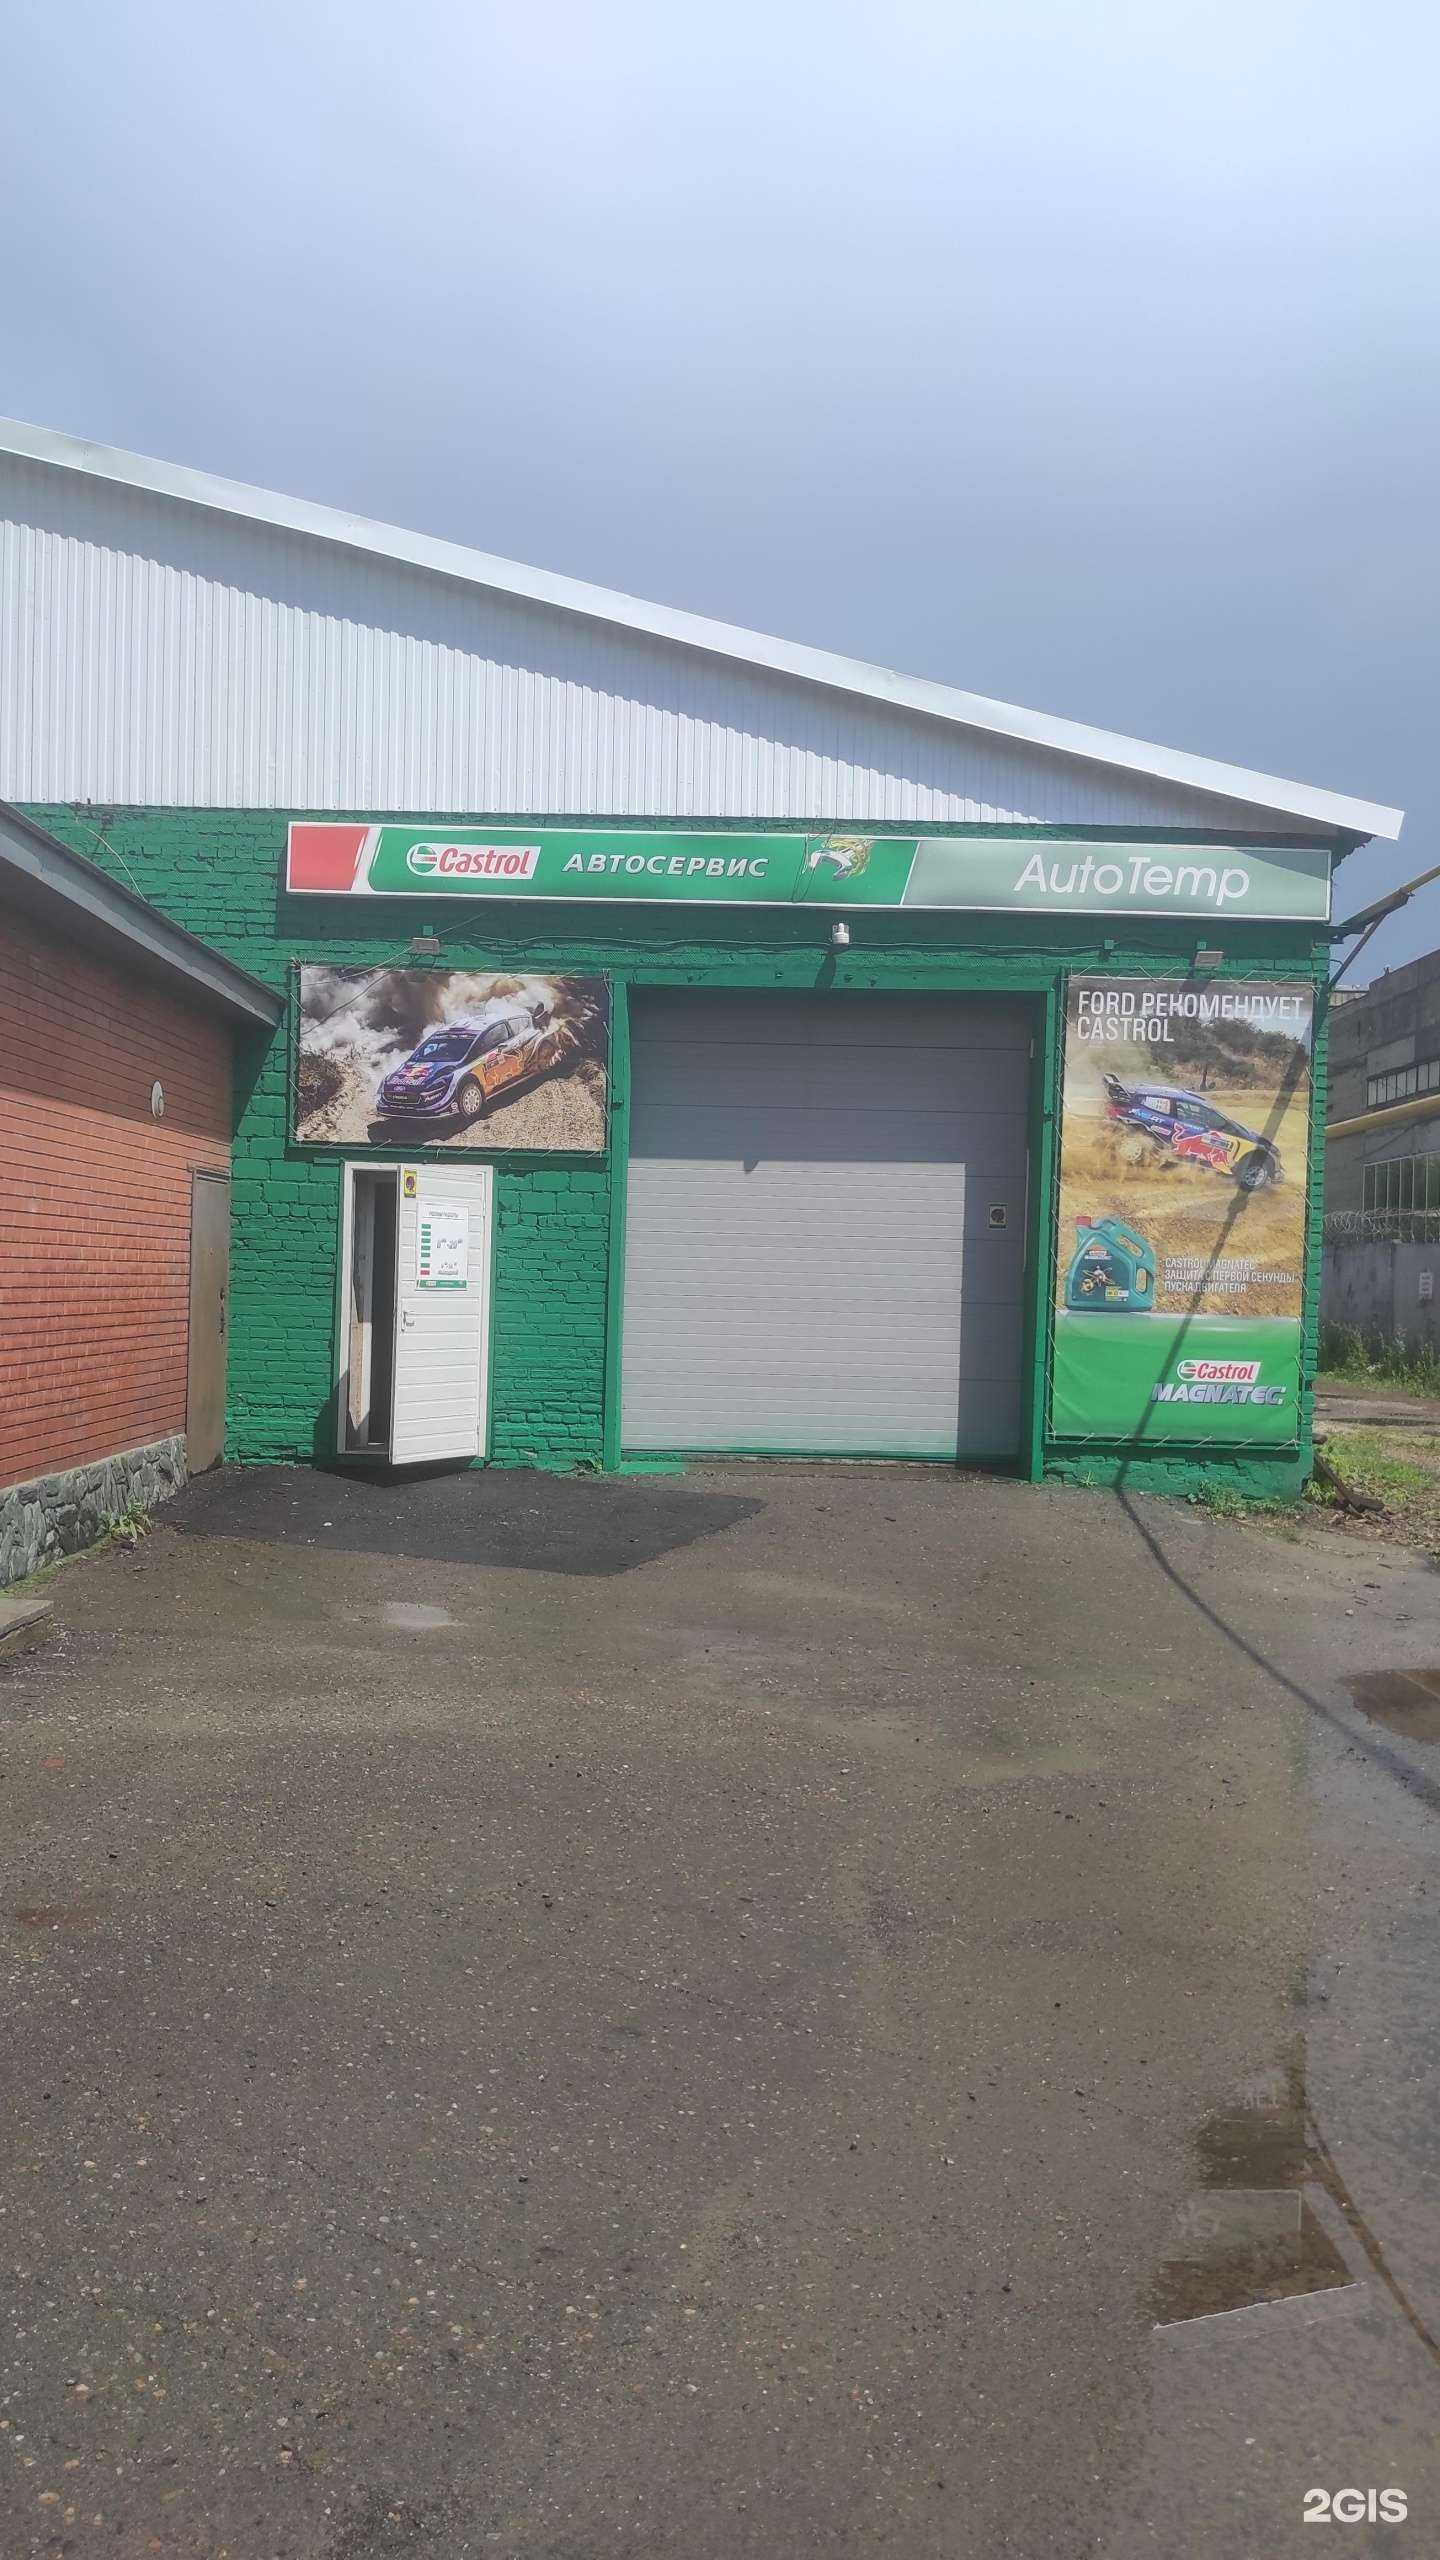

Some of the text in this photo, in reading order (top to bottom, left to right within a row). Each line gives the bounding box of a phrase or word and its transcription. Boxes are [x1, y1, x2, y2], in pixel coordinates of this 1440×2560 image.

[437, 846, 531, 875] Castrol
[562, 853, 769, 878] АВТОСЕРВИС
[1013, 854, 1250, 906] AutoTemp
[1077, 991, 1304, 1020] FORD РЕКОМЕНДУЕТ
[1077, 1016, 1175, 1042] CASTROL
[1164, 1280, 1193, 1292] ПУСКА
[1251, 1272, 1295, 1283] СЕКУНДЫ
[1197, 1362, 1255, 1380] Castrol
[1151, 1383, 1286, 1405] MAGNATEC
